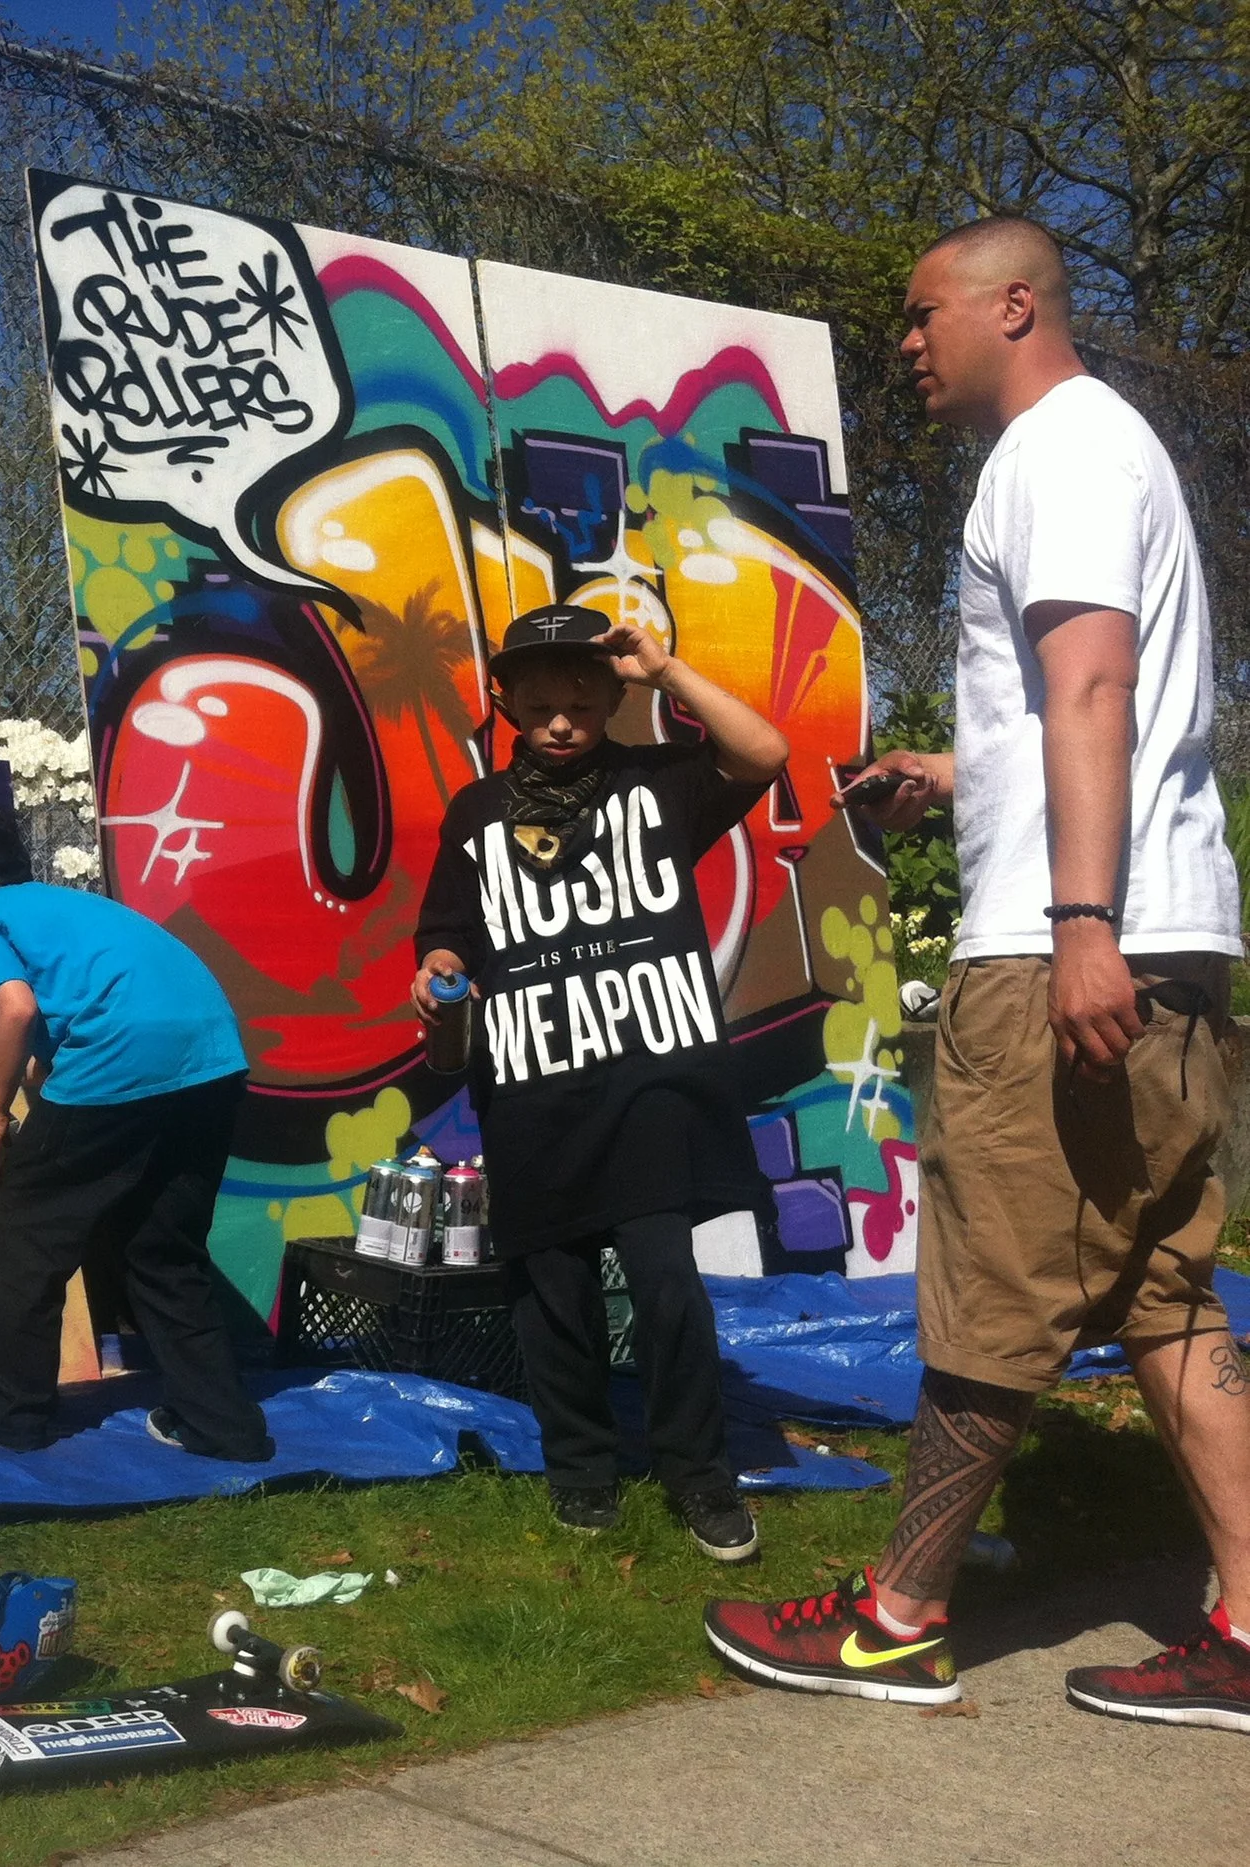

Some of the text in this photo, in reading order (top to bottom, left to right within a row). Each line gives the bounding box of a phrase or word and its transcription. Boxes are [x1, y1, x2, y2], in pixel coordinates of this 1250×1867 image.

[73, 274, 265, 364] RUDE
[54, 340, 313, 434] ROLLERS
[540, 940, 616, 967] IS THE
[484, 951, 718, 1085] WEAPON
[39, 1728, 169, 1749] THE HUNDREDS
